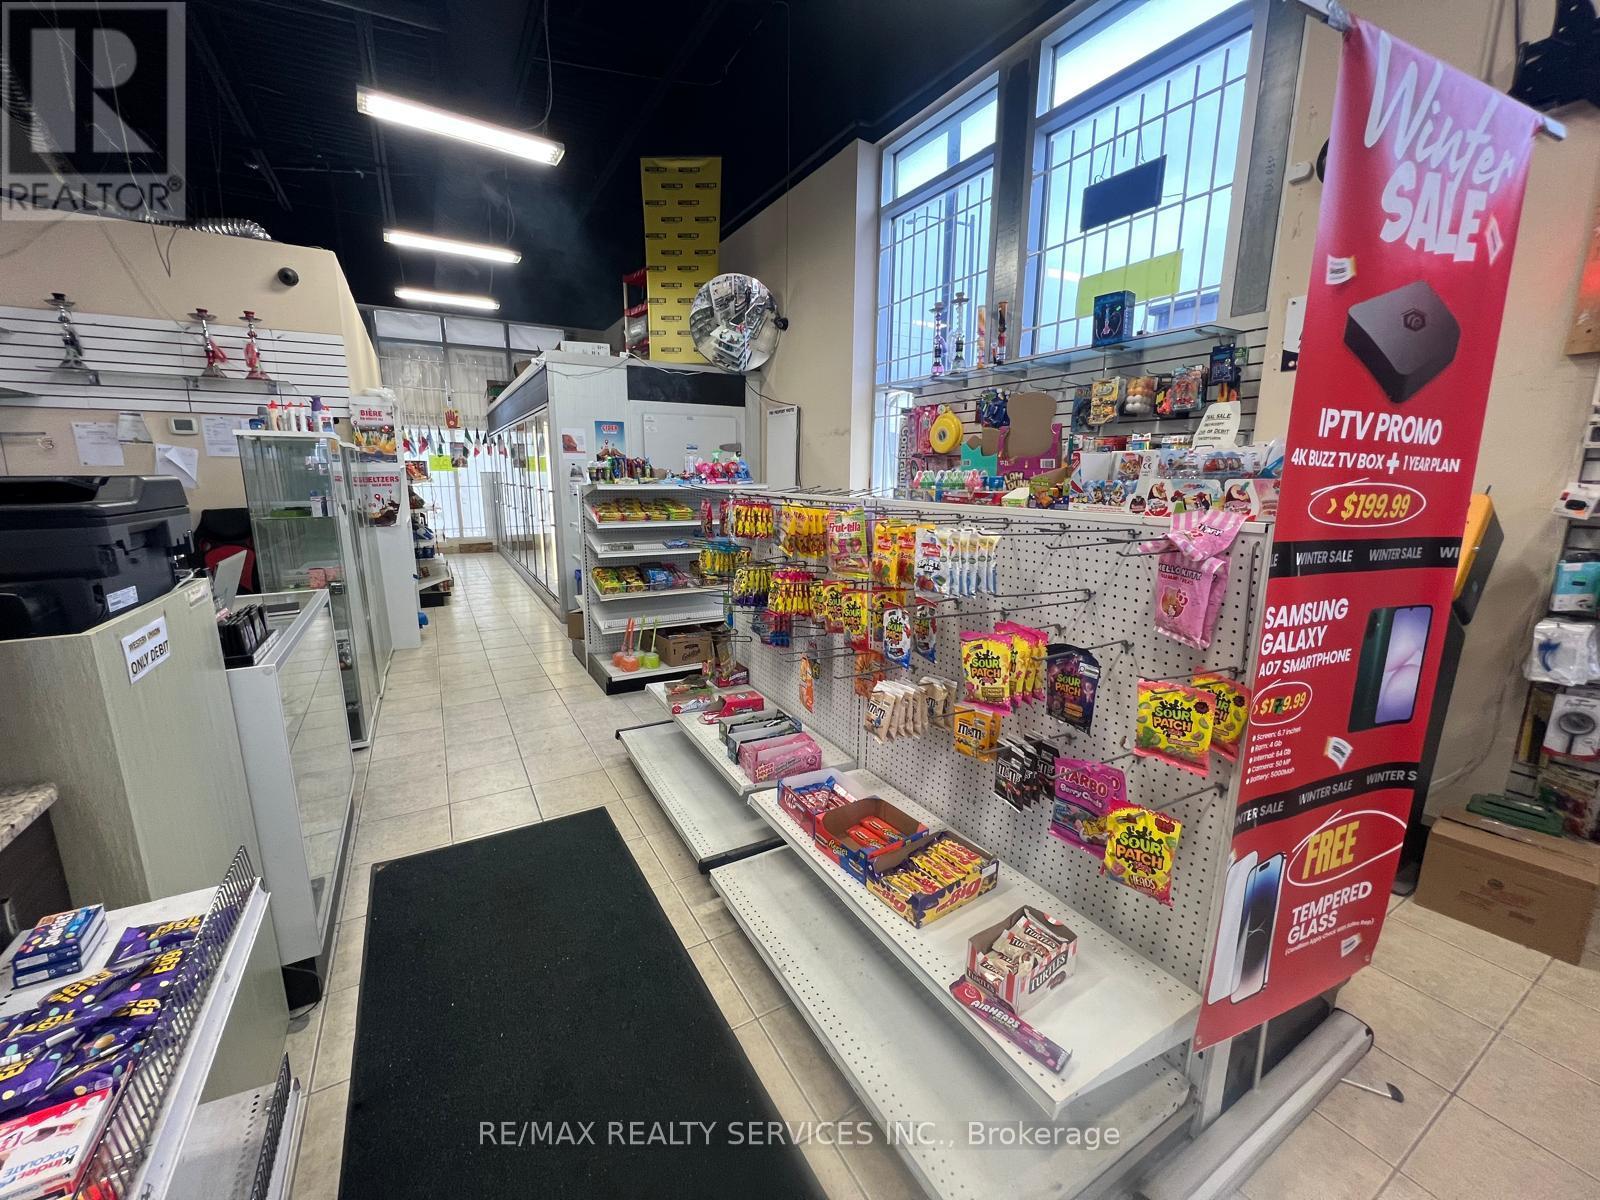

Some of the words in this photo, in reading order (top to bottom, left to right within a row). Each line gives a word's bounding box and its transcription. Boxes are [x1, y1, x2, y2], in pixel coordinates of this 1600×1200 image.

[1364, 30, 1513, 193] Winter
[1380, 162, 1488, 262] SALE
[360, 408, 382, 417] BIÈRE
[1318, 407, 1374, 440] IPTV
[1373, 412, 1442, 446] PROMO
[1291, 447, 1309, 466] 4K
[1308, 450, 1337, 467] BUZZ
[1337, 452, 1358, 468] TV
[1357, 454, 1386, 470] BOX
[1408, 455, 1431, 471] YEAR
[1430, 457, 1461, 473] PLAN
[1341, 491, 1411, 520] $199.99
[1296, 551, 1328, 566] WINTER
[1329, 549, 1354, 564] SALE
[1369, 547, 1402, 562] WINTER
[1401, 546, 1423, 560] SALE
[1181, 568, 1202, 581] KITTY
[1264, 597, 1349, 629] SAMSUNG
[1261, 624, 1328, 656] GALAXY
[130, 652, 150, 674] ONLY
[150, 640, 169, 662] DEBIT
[971, 657, 1000, 668] SOUR
[1258, 659, 1282, 678] A07
[1282, 648, 1352, 674] SMARTPHONE
[970, 667, 1001, 679] PATCH
[1056, 673, 1081, 688] SOUR
[1055, 683, 1081, 697] PATCH
[1153, 716, 1192, 732] PATCH
[1155, 706, 1191, 721] SOUR
[1254, 743, 1269, 752] Ram:
[1256, 731, 1277, 741] Screen:
[1252, 763, 1274, 773] Camera:
[1060, 782, 1082, 798] Berry
[1259, 800, 1285, 817] SALE
[1298, 784, 1332, 806] WINTER
[1331, 779, 1354, 794] SALE
[1366, 770, 1406, 785] WINTER
[1407, 770, 1418, 781] S
[1116, 844, 1164, 870] PATCH
[1120, 832, 1162, 857] SOUR
[1302, 820, 1360, 880] FREE
[1129, 874, 1156, 890] HEADS
[1292, 881, 1373, 926] TEMPERED
[1287, 910, 1338, 945] GLASS
[1030, 953, 1067, 993] TURTLES
[970, 999, 1021, 1029] AIRHEADS
[3, 1145, 79, 1178] CHOCOLATE
